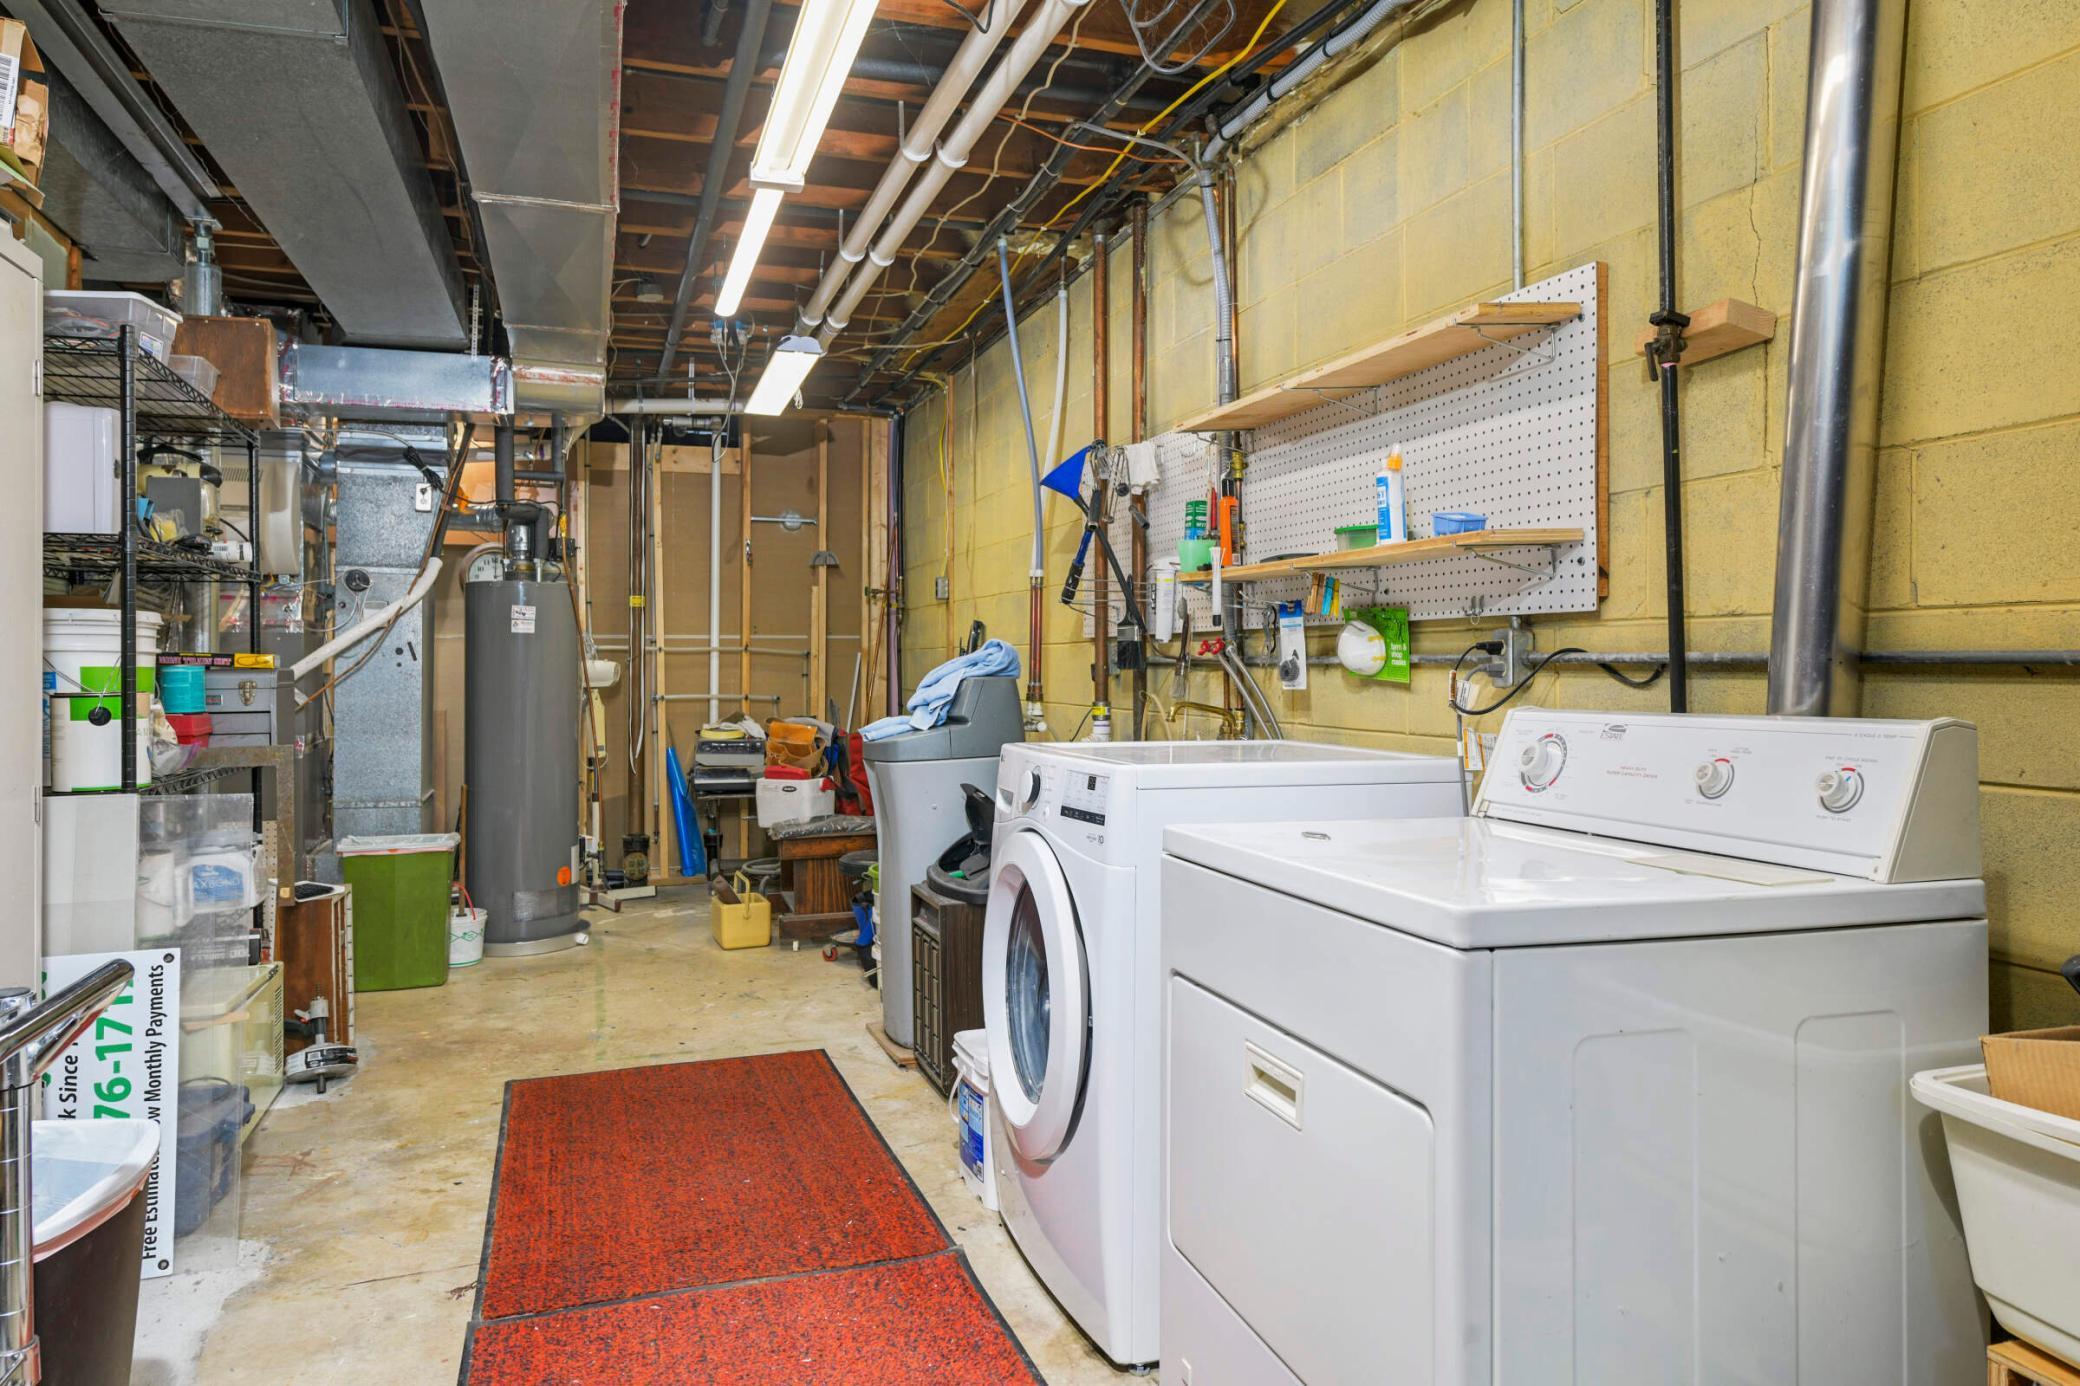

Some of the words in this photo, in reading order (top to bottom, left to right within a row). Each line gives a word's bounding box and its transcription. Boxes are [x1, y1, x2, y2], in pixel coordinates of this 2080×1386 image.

[145, 964, 168, 1037] Payments
[93, 977, 134, 1120] 76-171
[144, 1041, 168, 1102] Monthly
[58, 1055, 79, 1104] Since
[142, 1227, 158, 1260] Free
